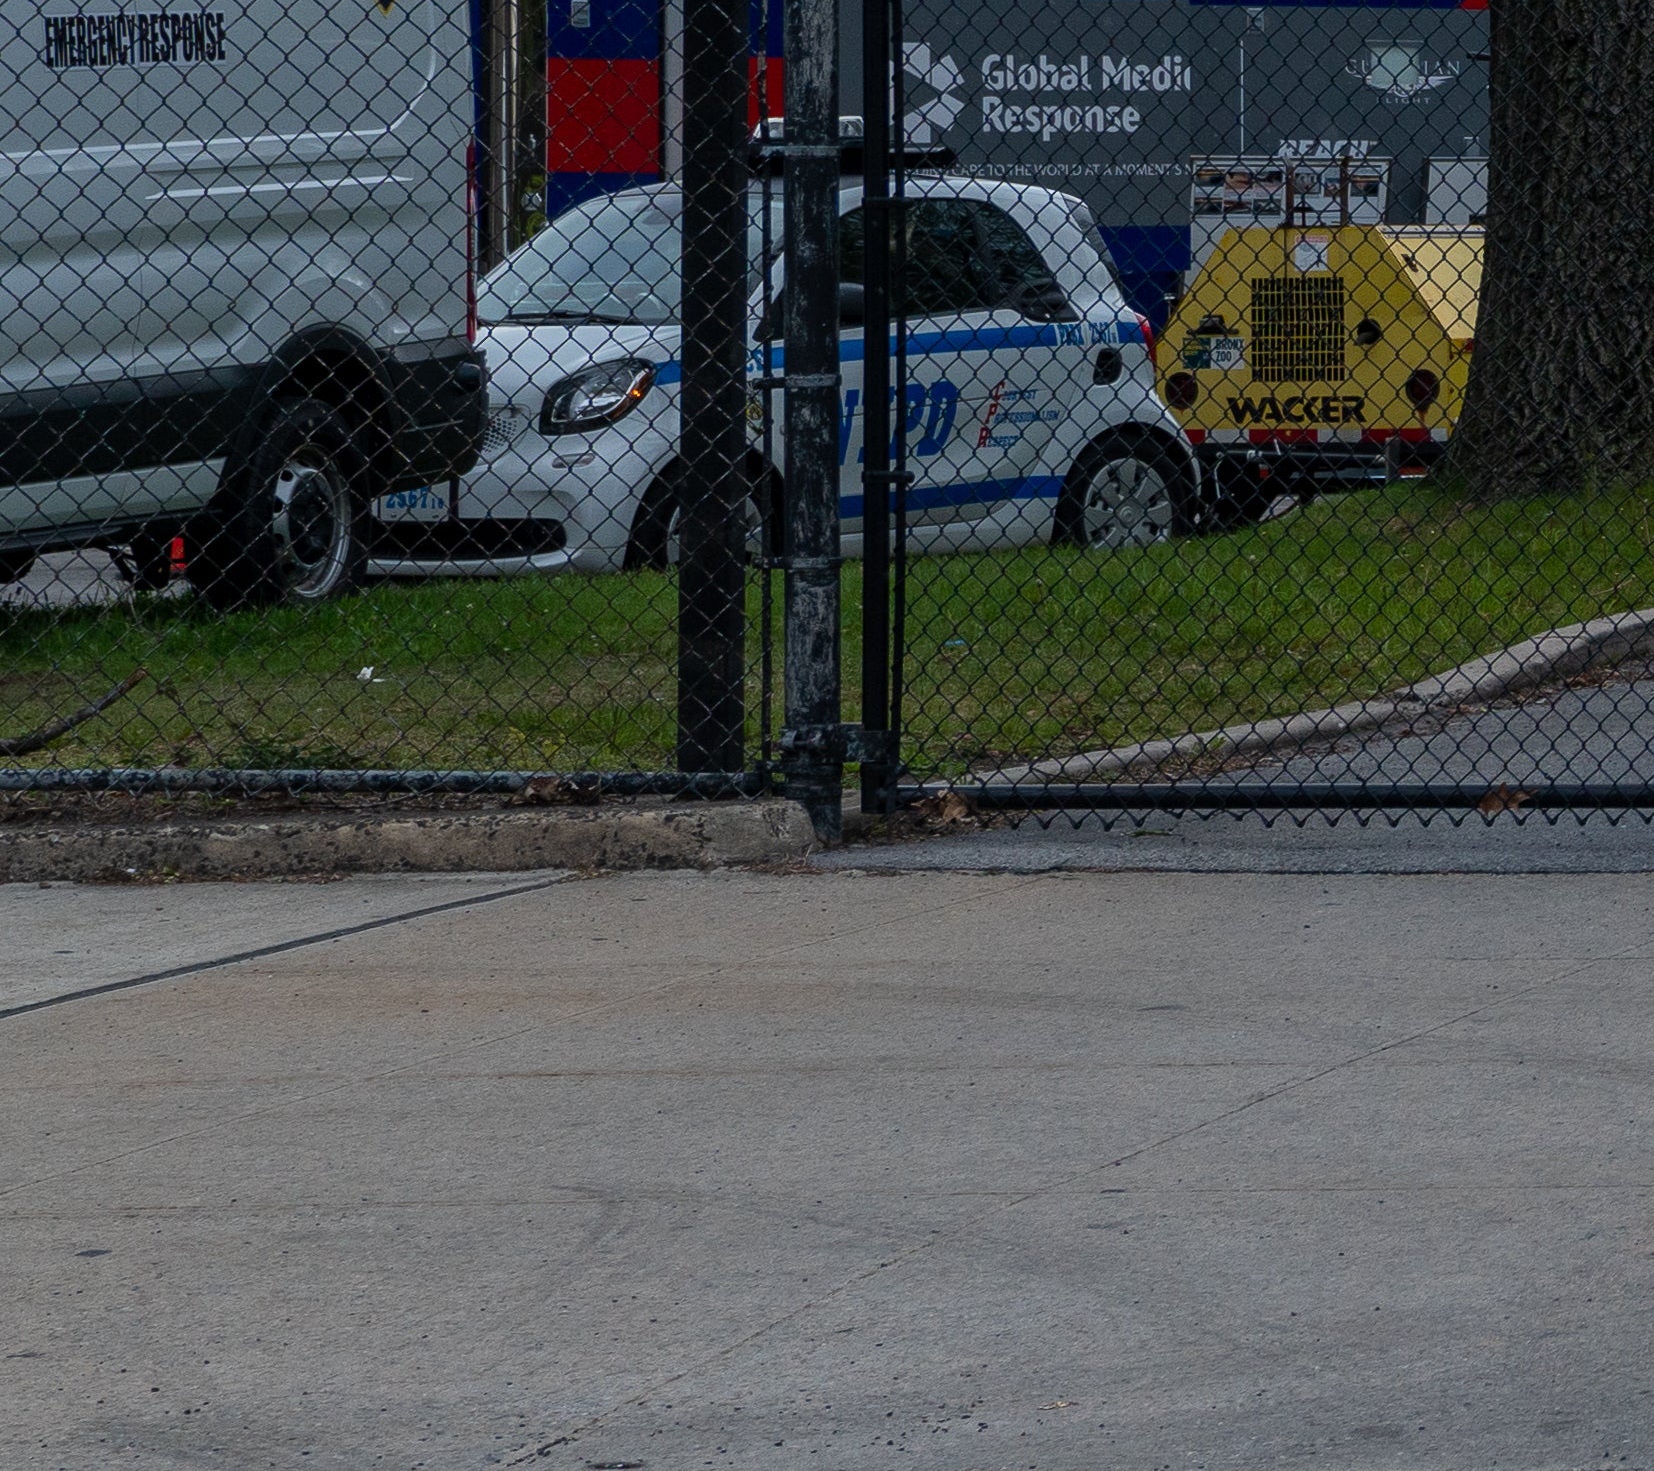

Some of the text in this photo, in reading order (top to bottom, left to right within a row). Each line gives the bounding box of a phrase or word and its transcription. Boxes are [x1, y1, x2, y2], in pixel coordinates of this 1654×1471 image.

[46, 12, 226, 68] EMERGENCY RESPONSE
[981, 54, 1091, 91] Global
[981, 96, 1140, 142] Response
[1226, 396, 1367, 423] WACKER
